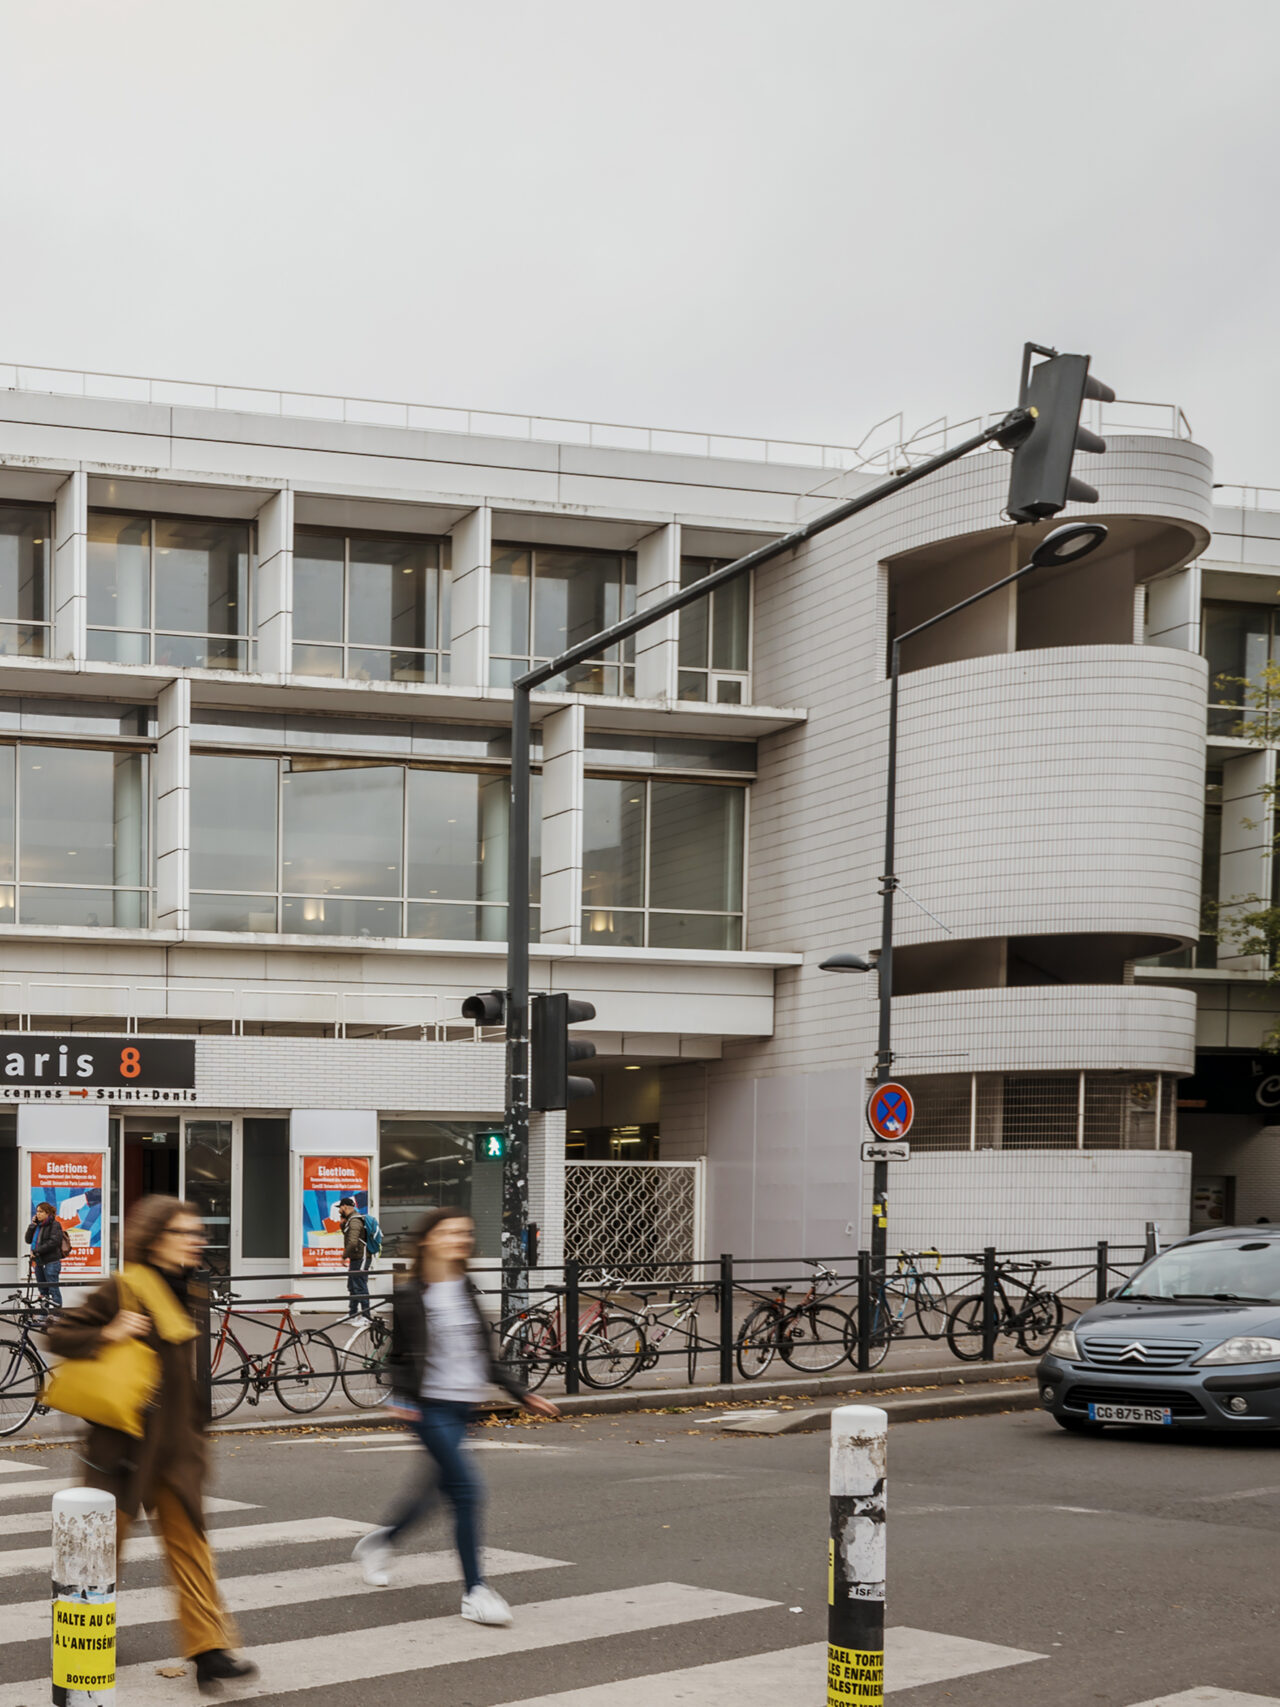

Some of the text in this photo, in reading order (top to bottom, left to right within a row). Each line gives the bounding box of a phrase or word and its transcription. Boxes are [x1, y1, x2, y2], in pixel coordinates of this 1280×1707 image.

[119, 1047, 141, 1079] 8
[96, 1088, 198, 1101] Saint-Denis
[46, 1162, 88, 1173] Elections
[318, 1166, 355, 1177] Elections
[1097, 1407, 1162, 1421] CG-875-RS
[57, 1610, 116, 1627] HALTE AU CH
[55, 1630, 60, 1646] À
[828, 1647, 851, 1664] RAEL
[829, 1661, 883, 1681] LES ENFANTS
[66, 1673, 107, 1686] BOYCOTT
